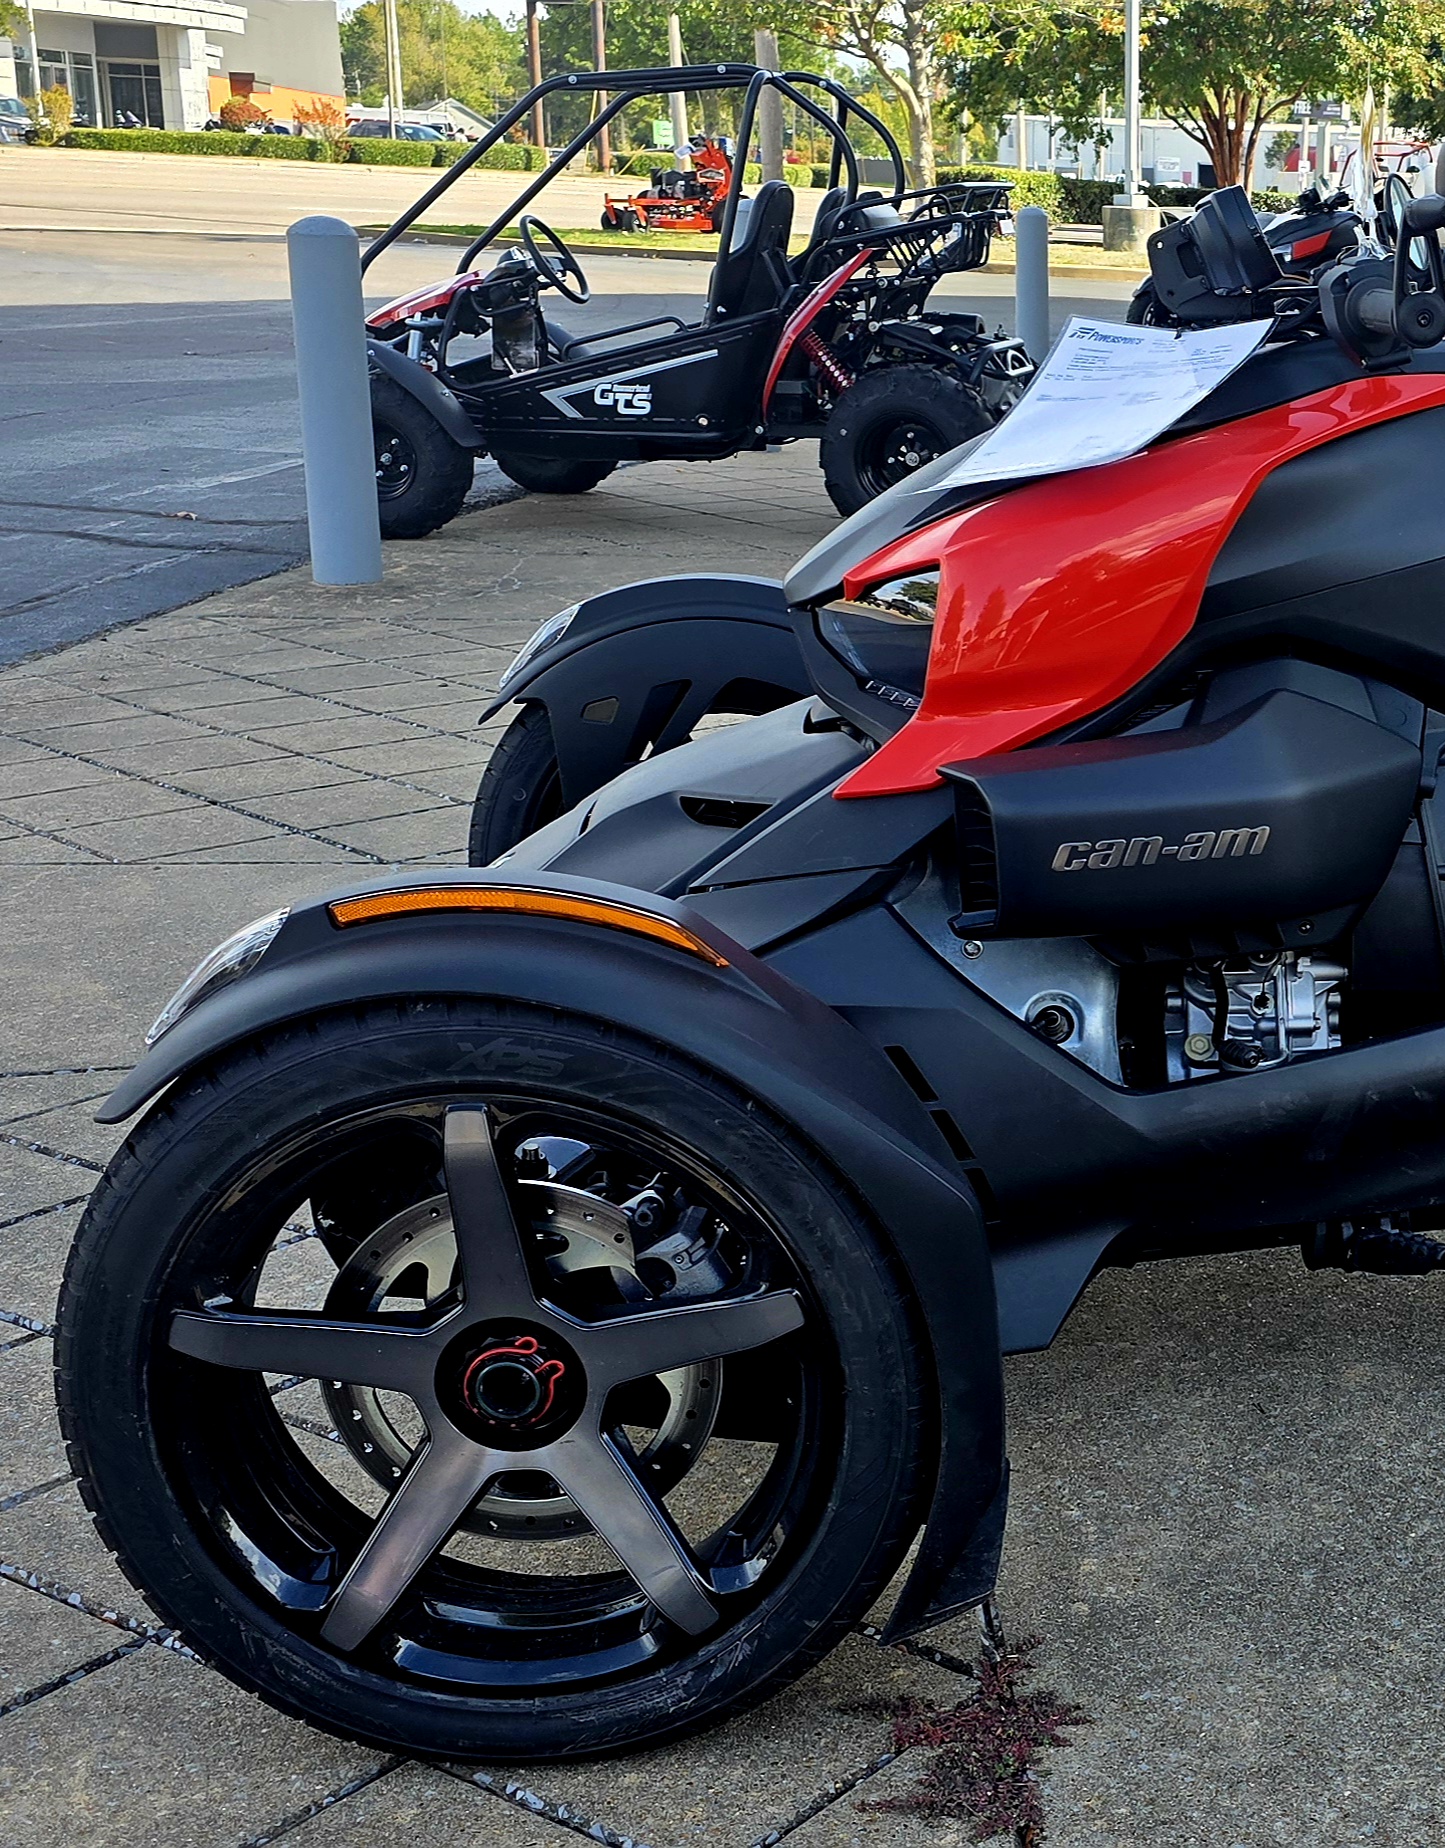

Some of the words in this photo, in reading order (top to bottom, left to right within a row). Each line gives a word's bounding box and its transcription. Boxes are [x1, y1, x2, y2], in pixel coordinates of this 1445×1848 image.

[594, 383, 652, 415] GTS
[1051, 825, 1271, 872] can-am
[446, 1037, 575, 1077] XPS
